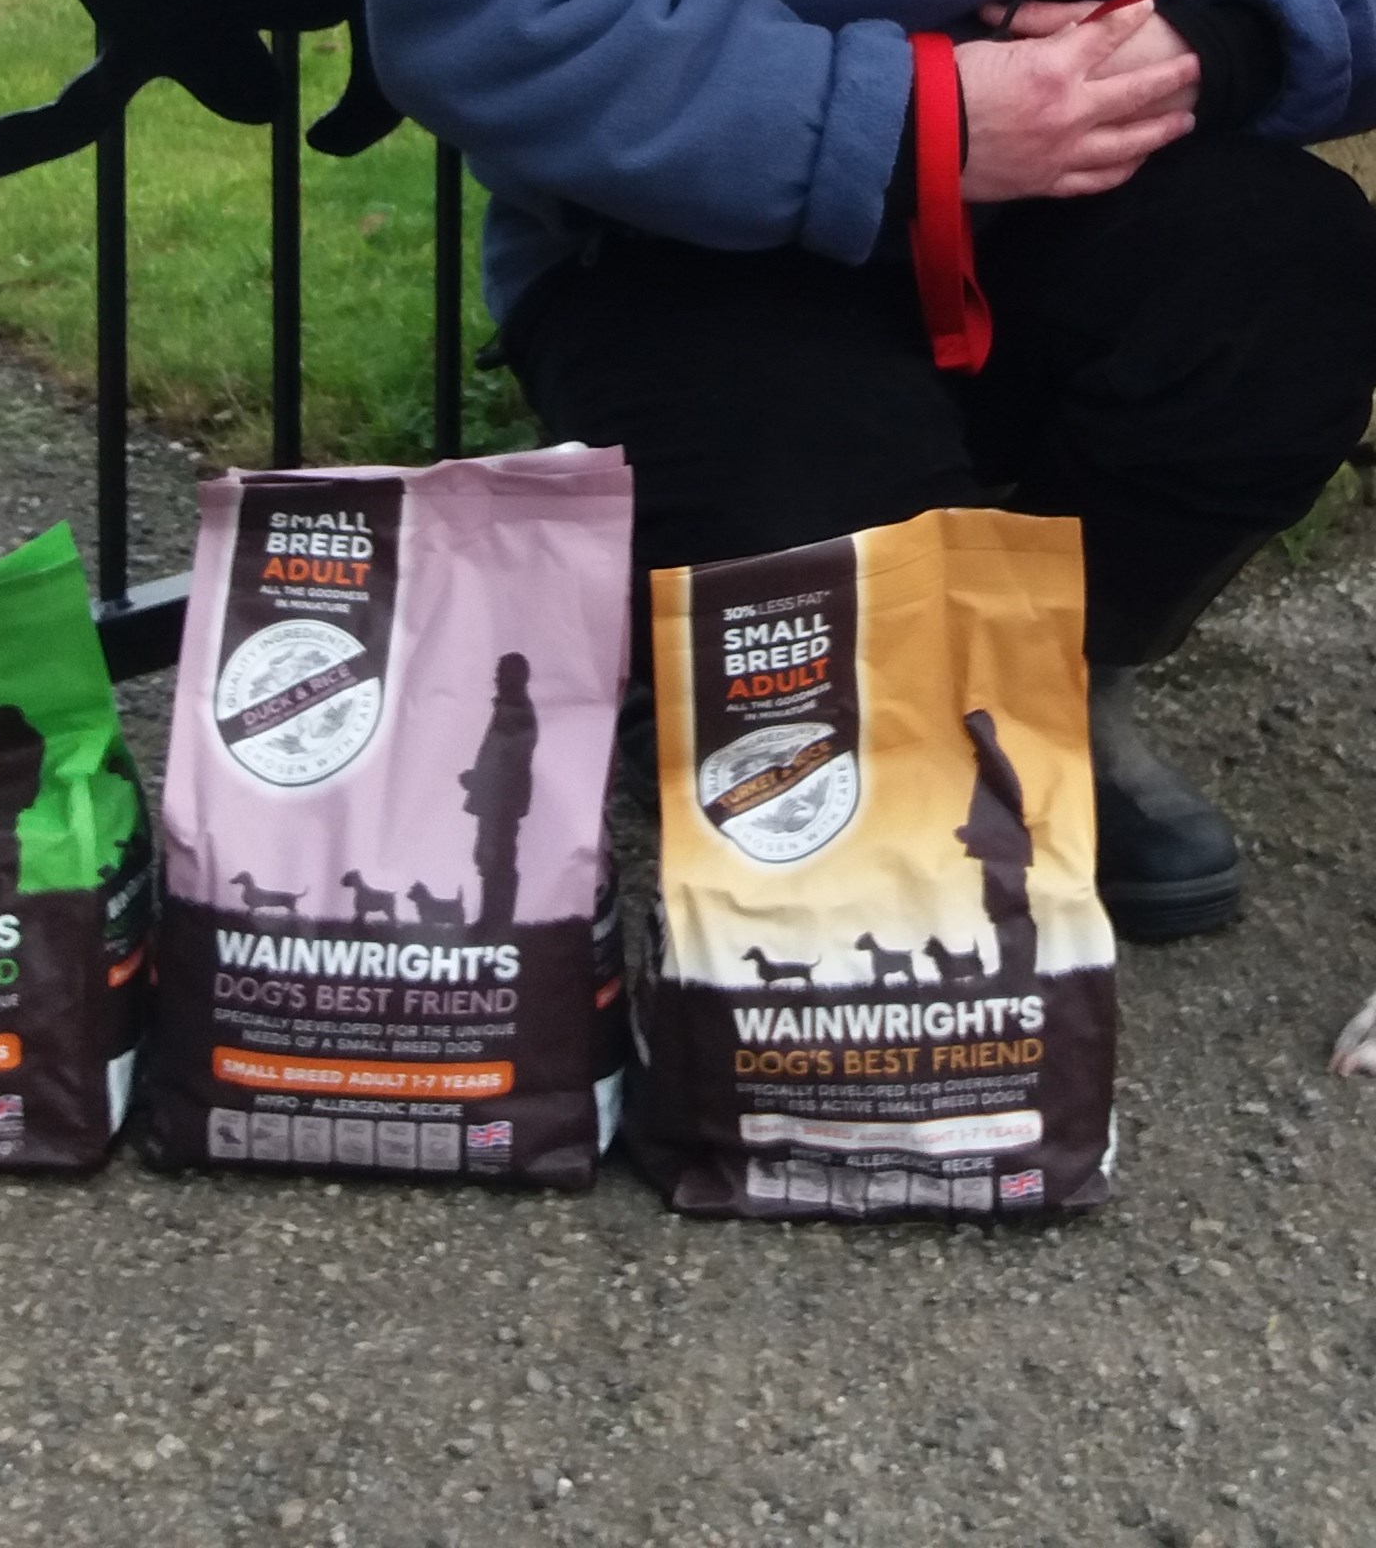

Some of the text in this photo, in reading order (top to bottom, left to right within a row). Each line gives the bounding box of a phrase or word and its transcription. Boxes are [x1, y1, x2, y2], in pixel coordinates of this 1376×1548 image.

[269, 511, 373, 533] SMALL
[265, 532, 373, 559] BREED
[261, 556, 371, 586] ADULT
[283, 585, 305, 596] THE
[723, 603, 757, 621] 30%
[758, 596, 795, 615] LESS
[724, 612, 832, 651] SMALL
[226, 627, 351, 709] QUALITY INGREDIENTS
[725, 635, 831, 677] BREED
[242, 663, 352, 726] DUCK & RICE
[726, 657, 831, 700] ADULT
[751, 698, 774, 709] THE
[243, 691, 374, 773] CHOSEN WITH CARE
[837, 764, 850, 806] CARE
[216, 928, 521, 984] WAINWRIGHT'S
[213, 972, 518, 1016] DOG'S BEST FRIEND
[213, 1007, 517, 1038] SPECIALLY DEVELOPED FOR THE UNIQUE
[733, 995, 1045, 1044] WAINWRIGHT'S
[242, 1029, 484, 1054] NEEDS OF A SMALL BREED DOG
[734, 1037, 1044, 1076] DOG'S BEST FRIEND
[223, 1057, 502, 1090] SMALL BREED ADULT 1-7 YEARS
[818, 1083, 906, 1098] DEVELOPED
[910, 1081, 942, 1096] FOR
[943, 1071, 1039, 1091] OVERWEIGHT
[312, 1097, 408, 1115] ALLERGENIC
[409, 1102, 464, 1118] RECIPE
[820, 1100, 873, 1113] ACTIVE
[878, 1098, 927, 1113] SMALL
[932, 1093, 976, 1111] BREED
[981, 1089, 1026, 1106] DOGS
